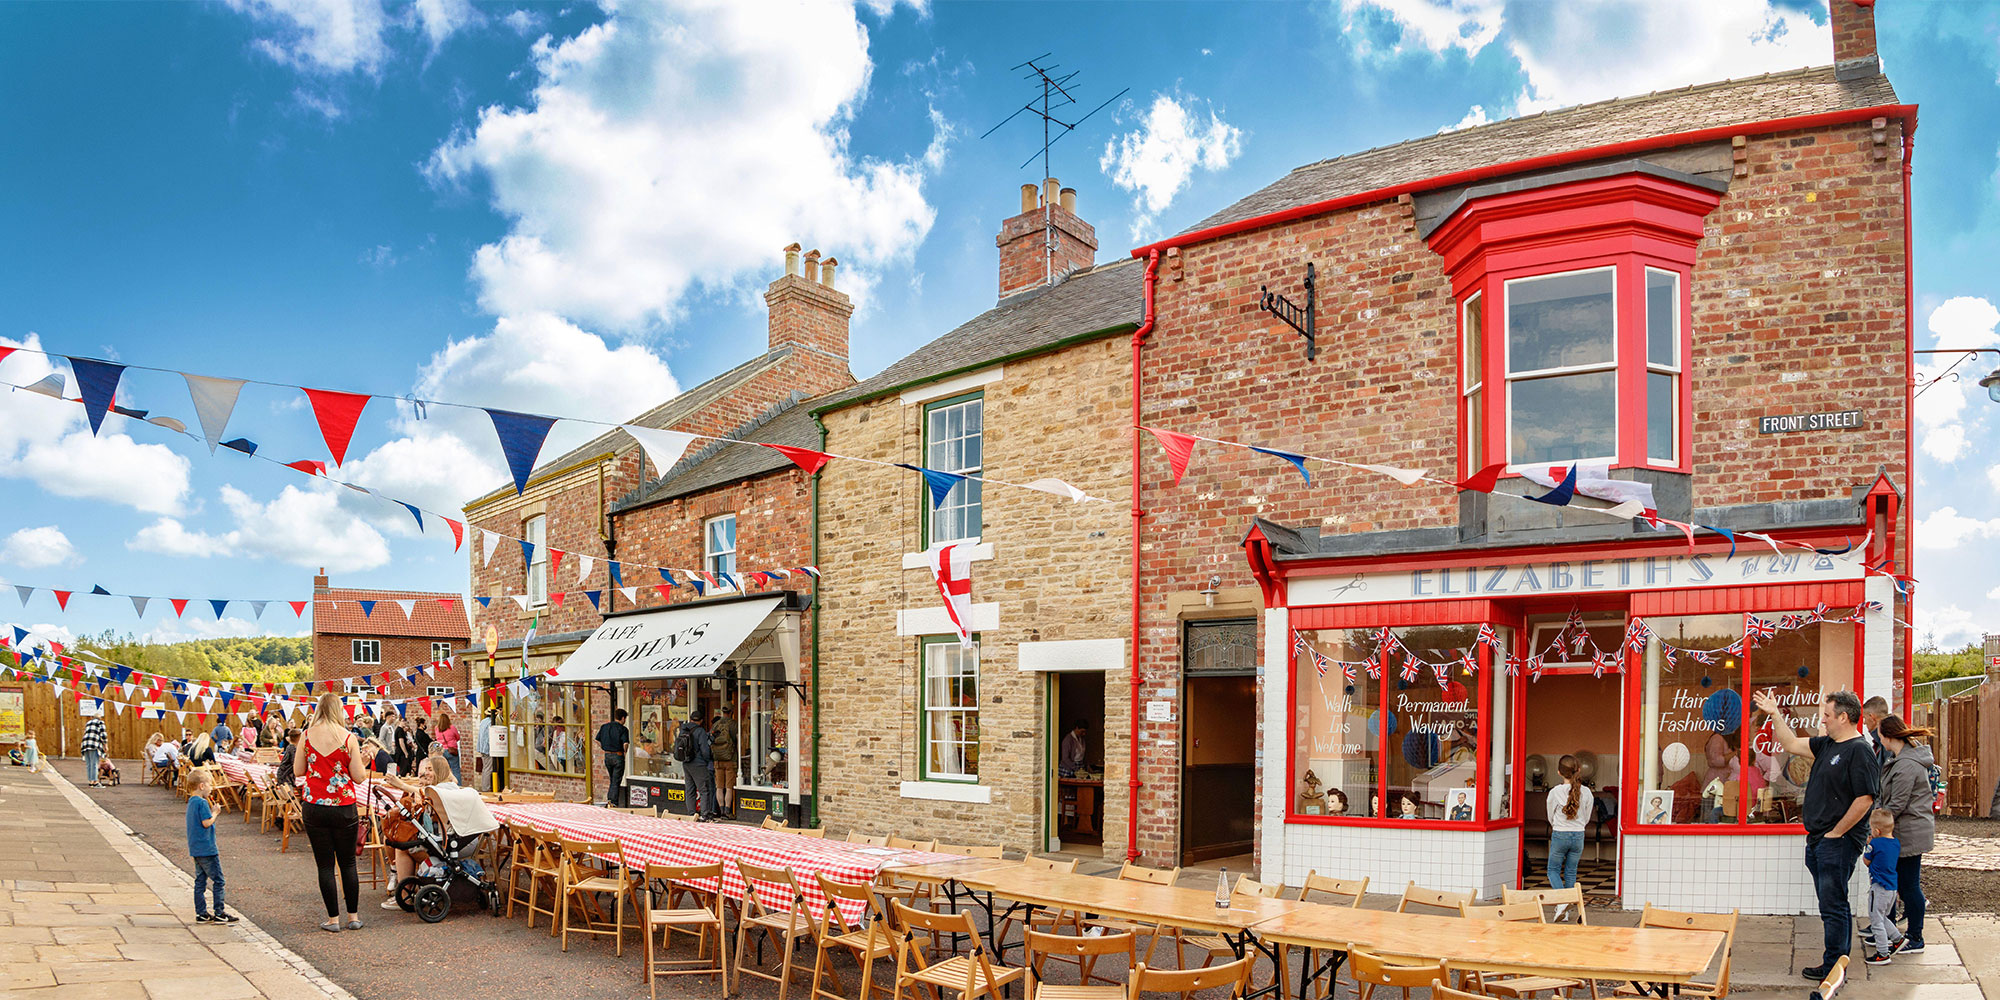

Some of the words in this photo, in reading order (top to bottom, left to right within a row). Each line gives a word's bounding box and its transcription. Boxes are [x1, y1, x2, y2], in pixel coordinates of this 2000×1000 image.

[1763, 416, 1804, 431] FRONT
[1809, 412, 1858, 428] STREET
[1411, 553, 1714, 596] ELIZABETH'S
[1741, 556, 1761, 577] Tel
[1767, 553, 1801, 575] 291
[598, 622, 710, 670] JOHN'S
[649, 653, 724, 671] GRILLS
[1323, 694, 1352, 712] Walk
[1397, 693, 1469, 712] Permanent
[1672, 688, 1709, 709] Hair
[1328, 715, 1351, 733] Ins
[1409, 714, 1454, 742] Waving
[1659, 712, 1725, 732] Fashions
[1313, 736, 1361, 754] Welcome
[669, 793, 684, 801] NEWS
